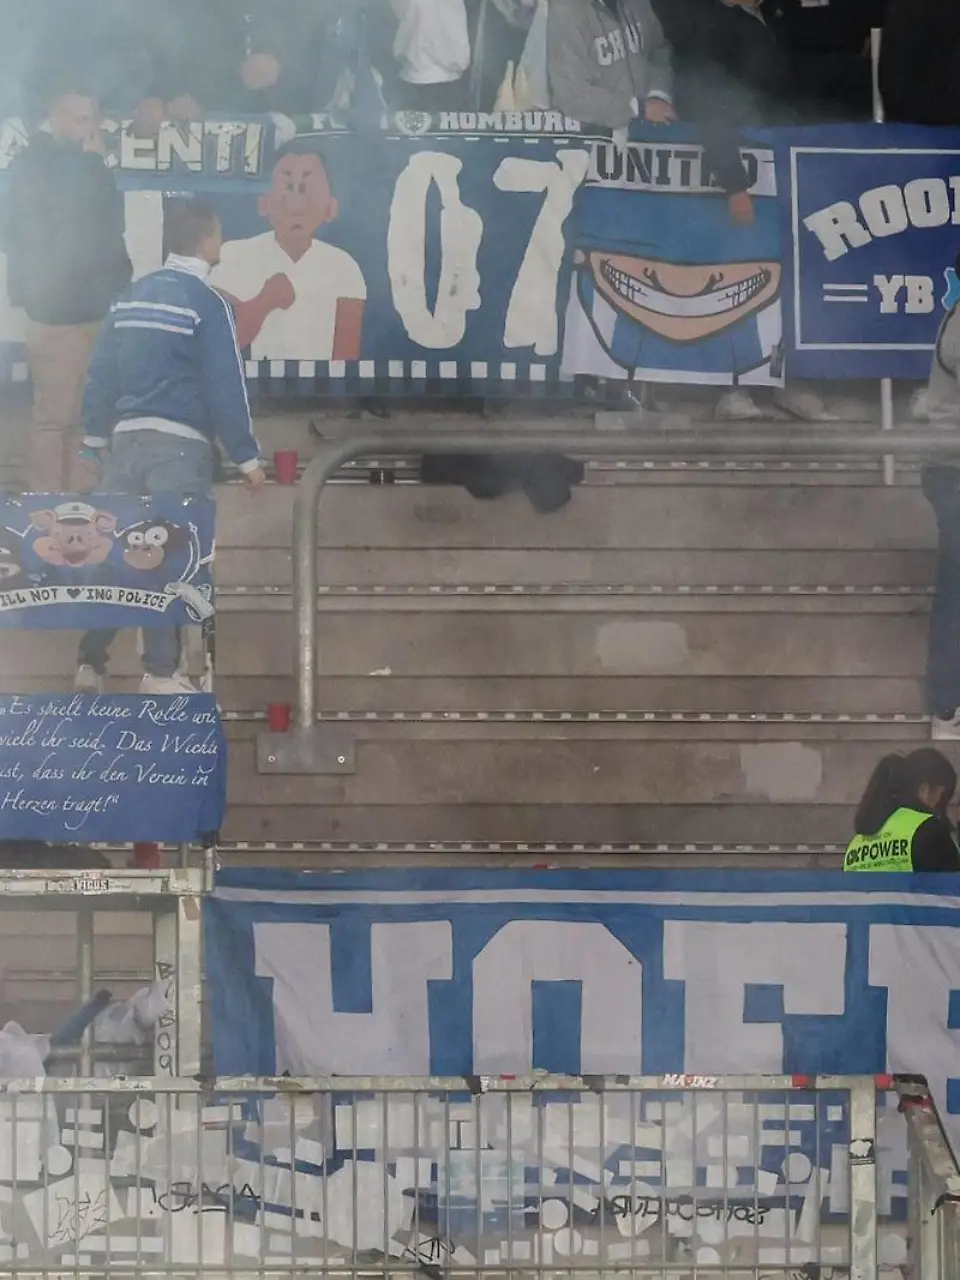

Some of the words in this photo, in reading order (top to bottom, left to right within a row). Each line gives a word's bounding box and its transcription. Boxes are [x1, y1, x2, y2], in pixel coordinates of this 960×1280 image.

[595, 144, 758, 187] UNITD
[387, 149, 590, 356] 07
[30, 587, 58, 602] NOT
[118, 588, 167, 609] POLICE
[87, 695, 132, 719] keine
[138, 696, 189, 727] Rolle
[115, 729, 153, 752] Das
[32, 752, 65, 781] dass
[99, 754, 128, 783] den
[134, 761, 189, 786] Verein
[0, 788, 58, 815] Herzen
